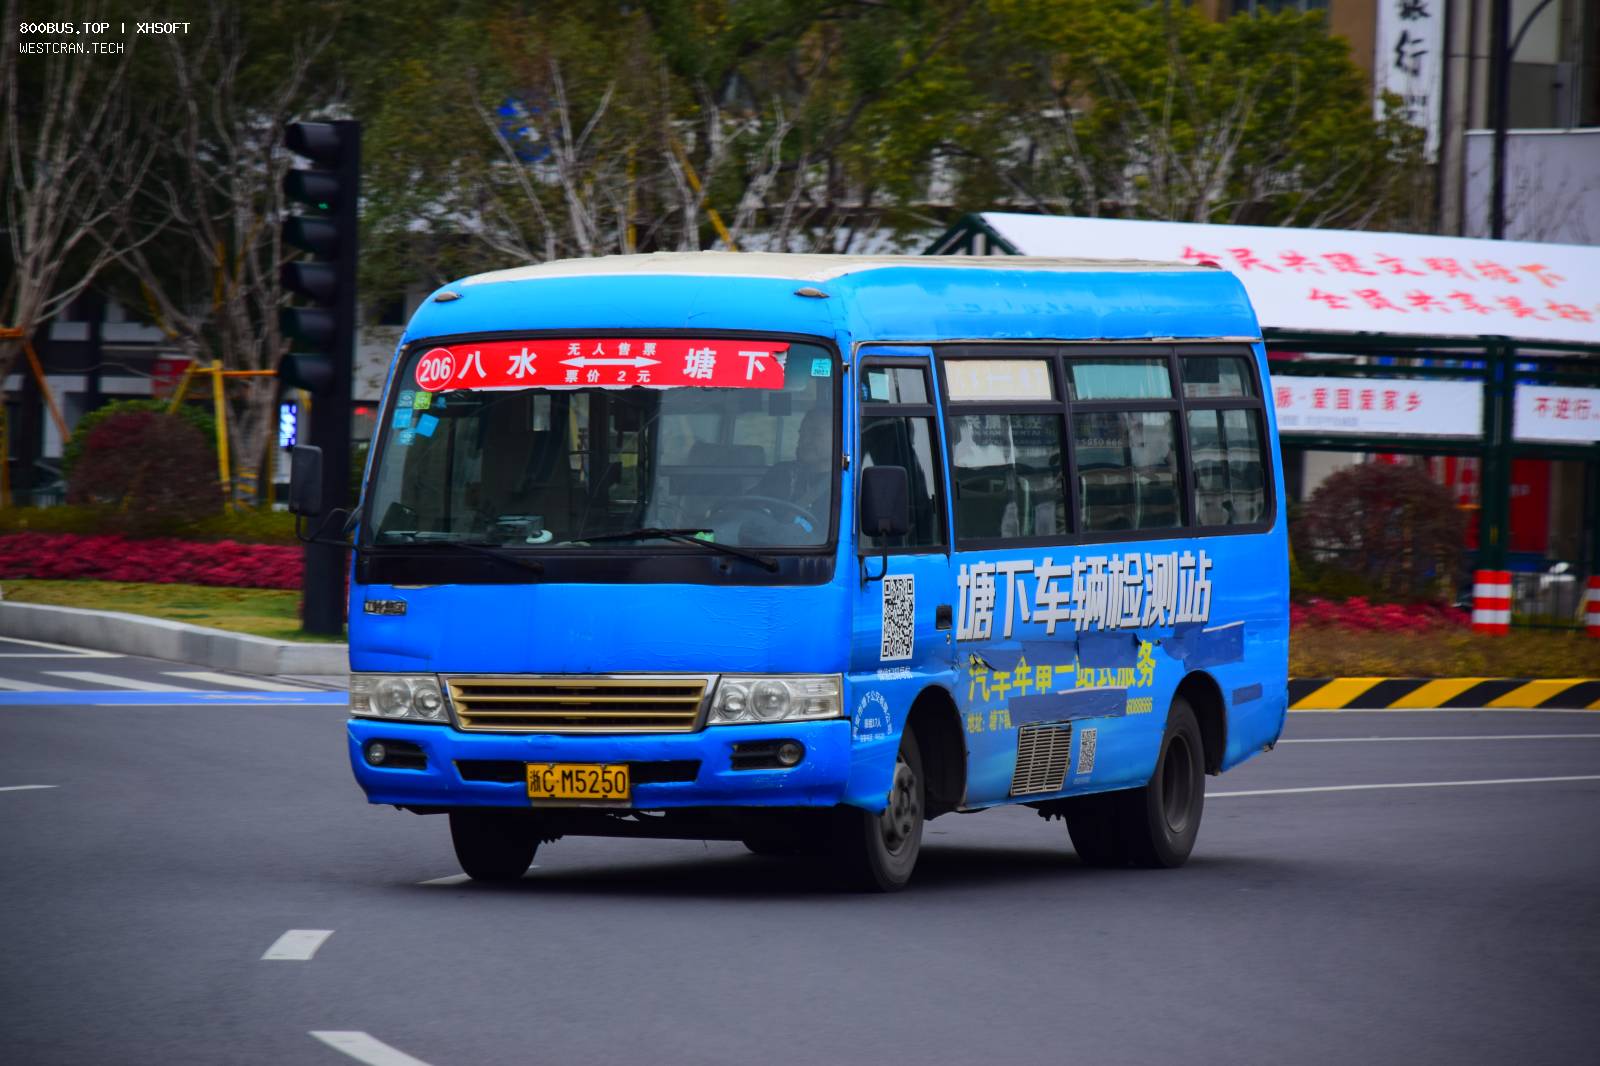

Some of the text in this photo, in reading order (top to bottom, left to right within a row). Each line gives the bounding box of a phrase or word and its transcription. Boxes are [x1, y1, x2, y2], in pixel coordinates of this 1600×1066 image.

[1307, 287, 1600, 323] 全民共享美好
[419, 346, 770, 383] 206 八水 塘下
[567, 341, 656, 358] 无人售票
[956, 549, 1213, 642] 塘下车辆检测站
